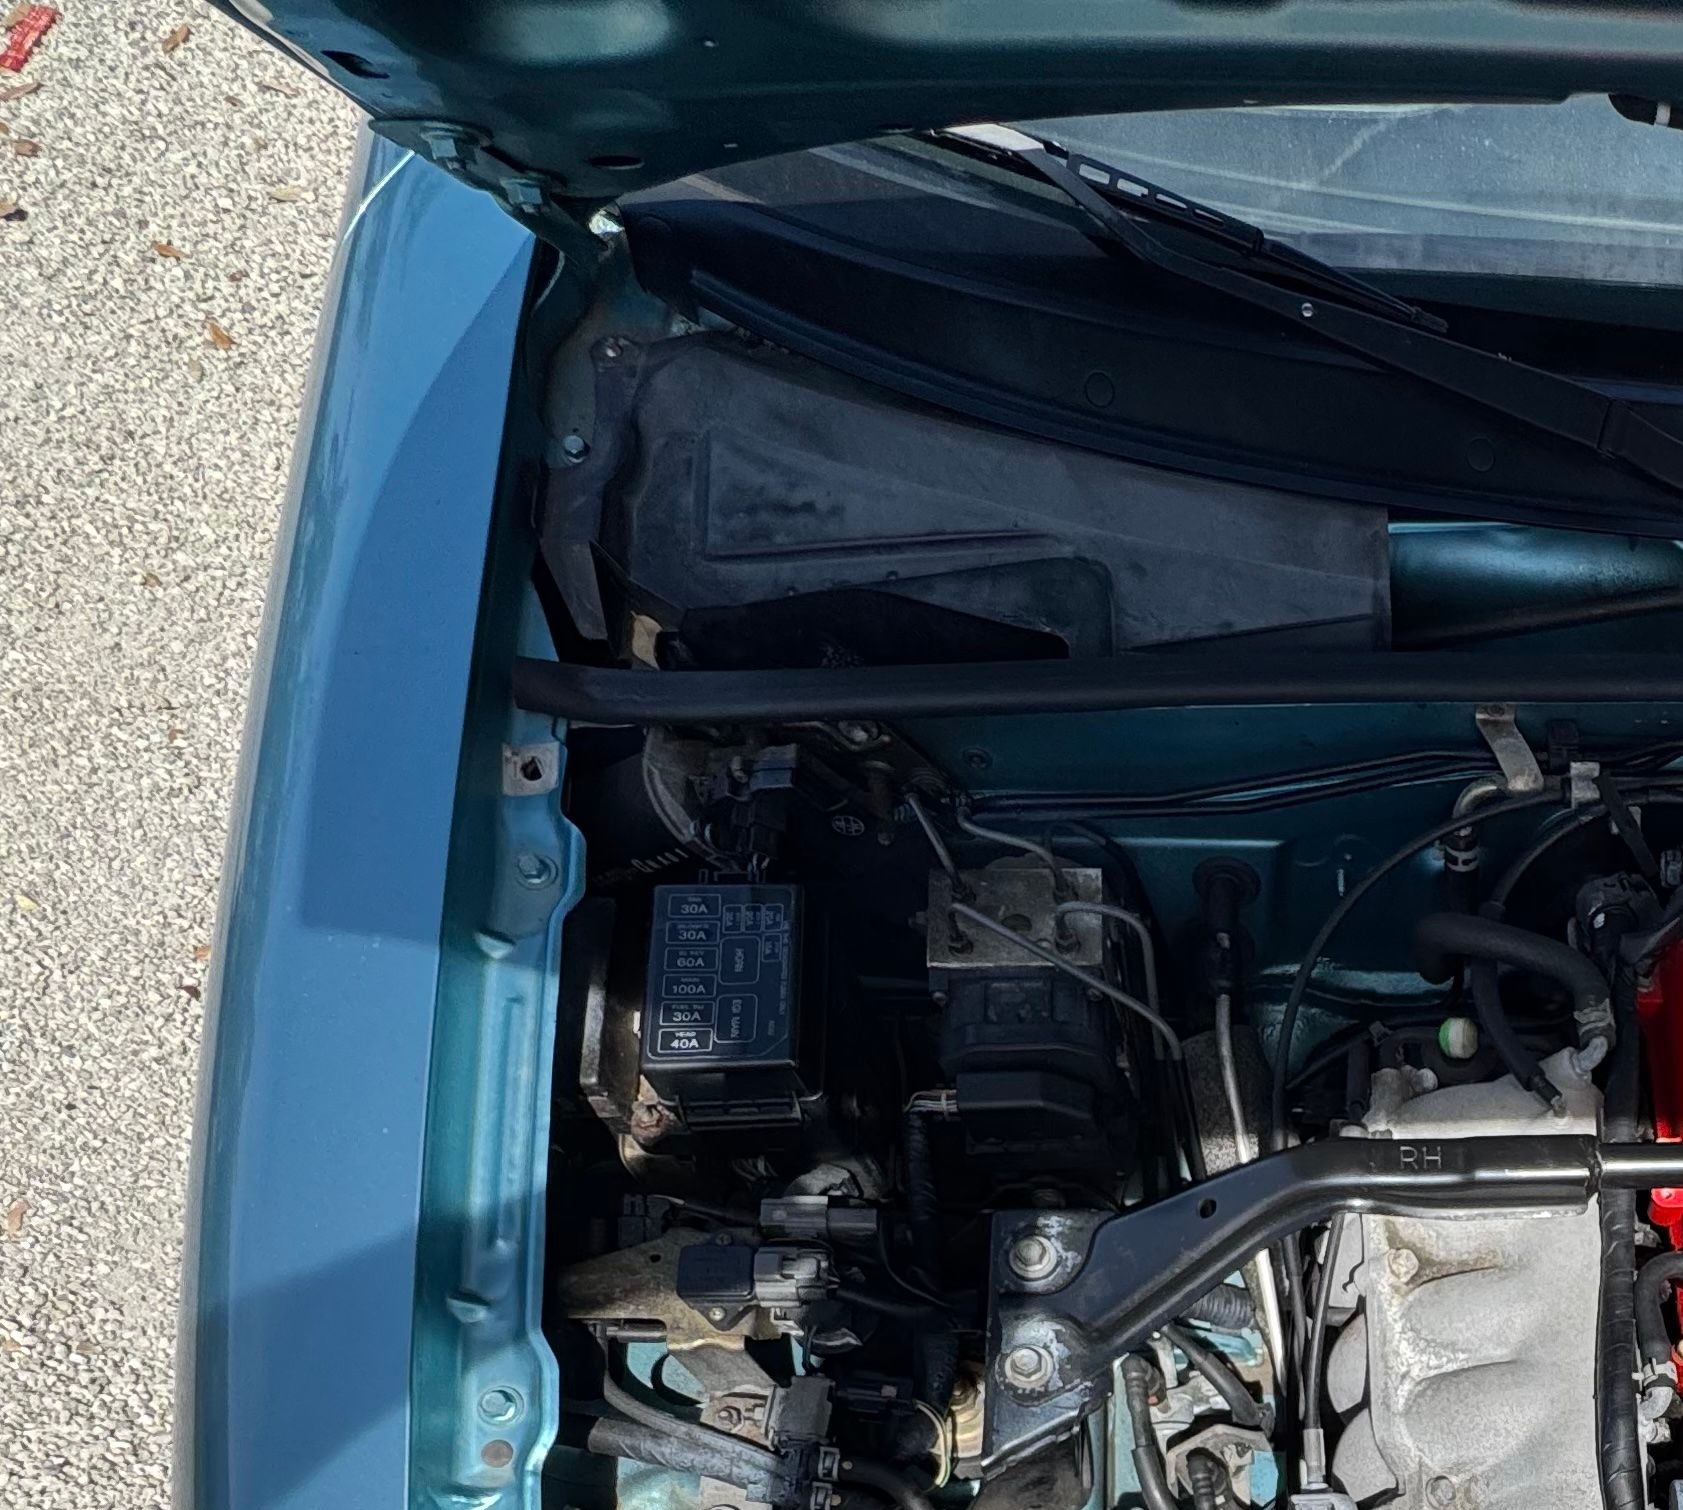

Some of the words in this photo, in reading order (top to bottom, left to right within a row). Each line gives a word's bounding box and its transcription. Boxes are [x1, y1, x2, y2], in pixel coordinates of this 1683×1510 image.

[680, 904, 708, 914] 30A
[678, 930, 707, 941] 30A
[676, 957, 705, 967] 60A
[672, 984, 706, 995] 100A
[672, 1012, 702, 1022] 30A
[669, 1038, 700, 1049] 40A
[1400, 1145, 1442, 1170] RH
